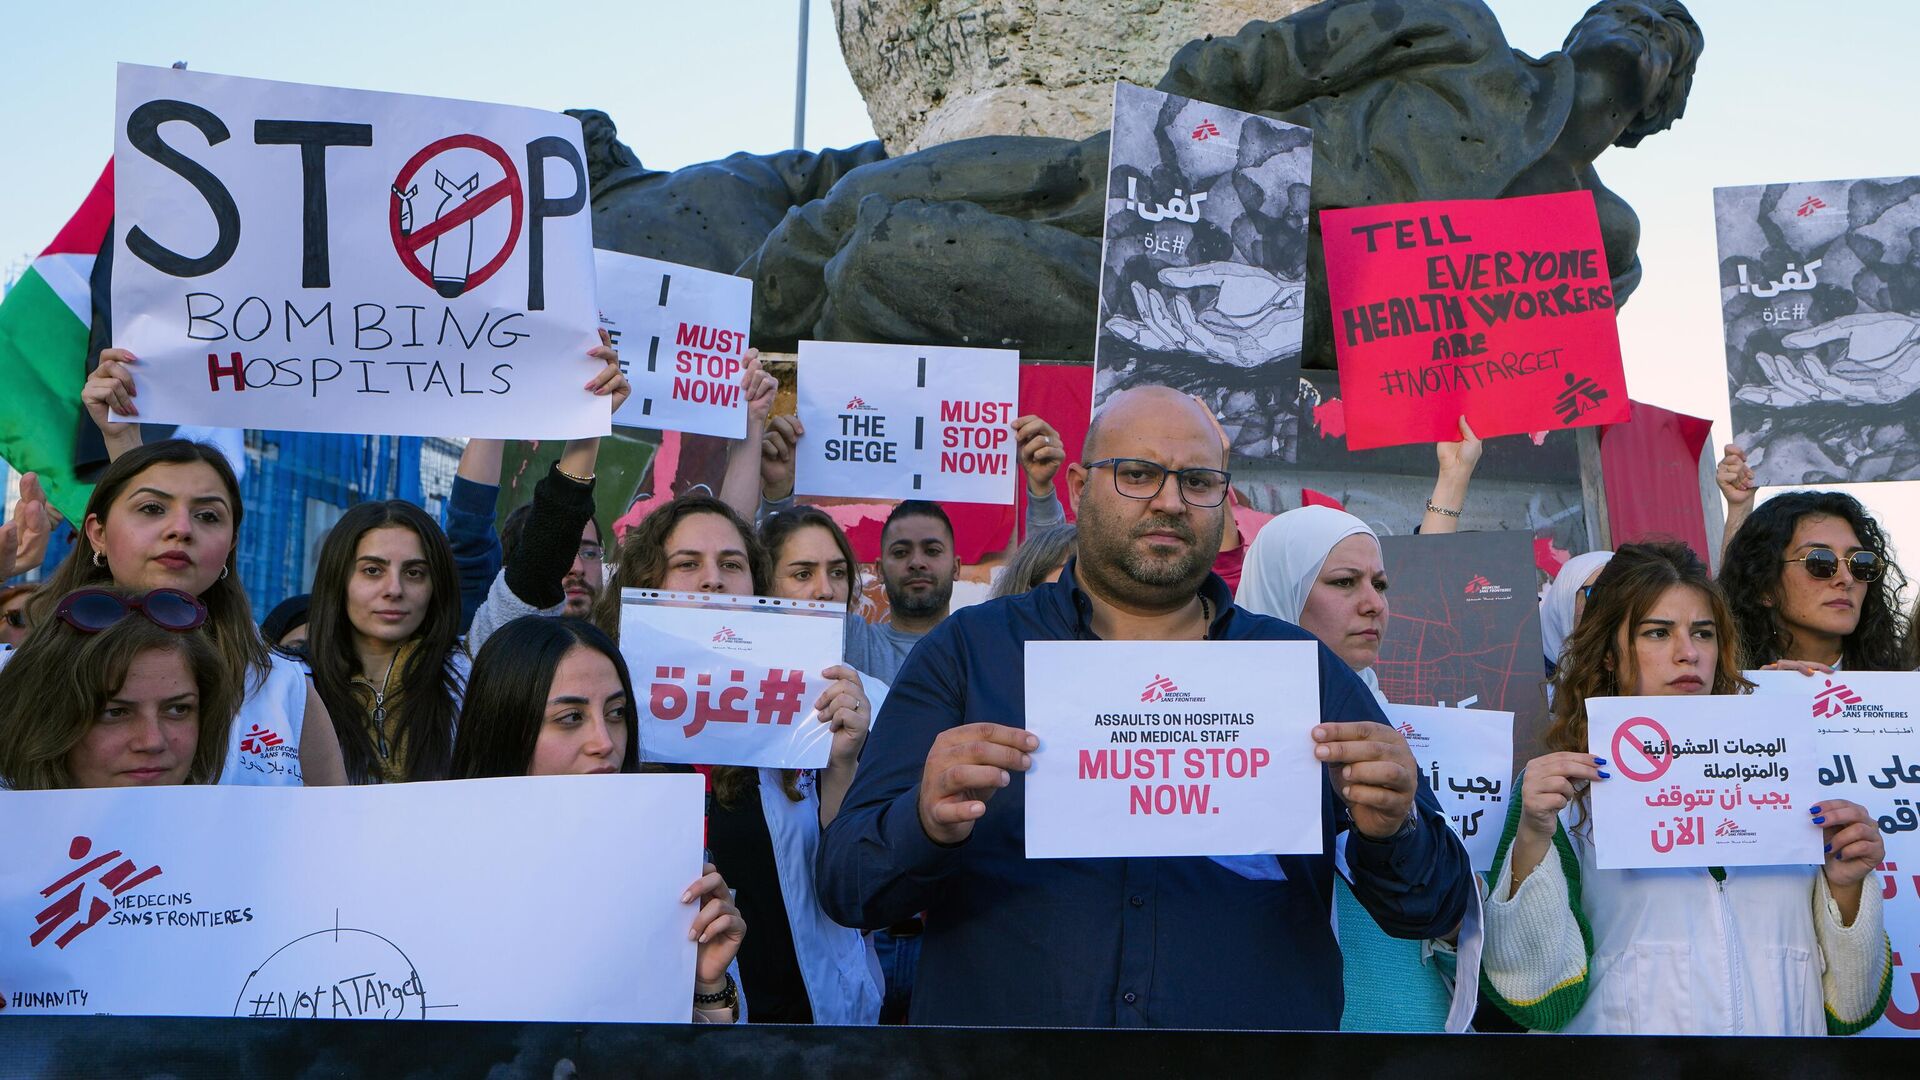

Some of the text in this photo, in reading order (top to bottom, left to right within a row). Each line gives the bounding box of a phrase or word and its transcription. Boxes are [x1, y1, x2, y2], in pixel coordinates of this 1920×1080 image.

[126, 99, 588, 311] STOP
[1126, 176, 1208, 224] كفى!
[1143, 232, 1186, 254] #غزة
[1351, 214, 1472, 252] TELL
[1426, 249, 1599, 291] EVERYONE
[1737, 259, 1823, 298] كفى!
[186, 292, 530, 351] BOMBING
[1342, 283, 1615, 347] HEALTH WORKERS
[1762, 303, 1806, 326] #غزة
[675, 321, 746, 355] MUST
[1432, 333, 1489, 360] ARE
[207, 351, 514, 398] HOSPITALS
[675, 350, 740, 380] STOP
[1379, 348, 1564, 399] #NOTATARGET
[672, 376, 741, 408] NOW!
[838, 413, 886, 438] THE
[940, 400, 1013, 424] MUST
[824, 439, 897, 463] SIEGE
[943, 426, 1008, 449] STOP
[940, 451, 1008, 475] NOW!
[650, 666, 806, 739] #غزة
[1846, 704, 1884, 712] MEDECINS
[1863, 711, 1909, 719] FRONTIERES
[1094, 713, 1255, 726] ASSAULTS ON HOSPITALS
[265, 745, 298, 754] MEDECINS
[1110, 730, 1240, 743] AND MEDICAL STAFF
[1643, 737, 1787, 759] الهجمات العشوائية
[260, 751, 279, 759] SANS
[1078, 747, 1270, 779] MUST STOP
[1703, 762, 1789, 782] والمتواصلة
[1129, 784, 1220, 815] NOW.
[1447, 775, 1502, 802] يجب
[1645, 783, 1792, 812] يجب أن تتوقف
[1651, 816, 1705, 853] الآن
[114, 892, 192, 910] MEDECINS
[108, 907, 254, 928] SANS FRONTIERES
[12, 989, 88, 1008] HUMANITY
